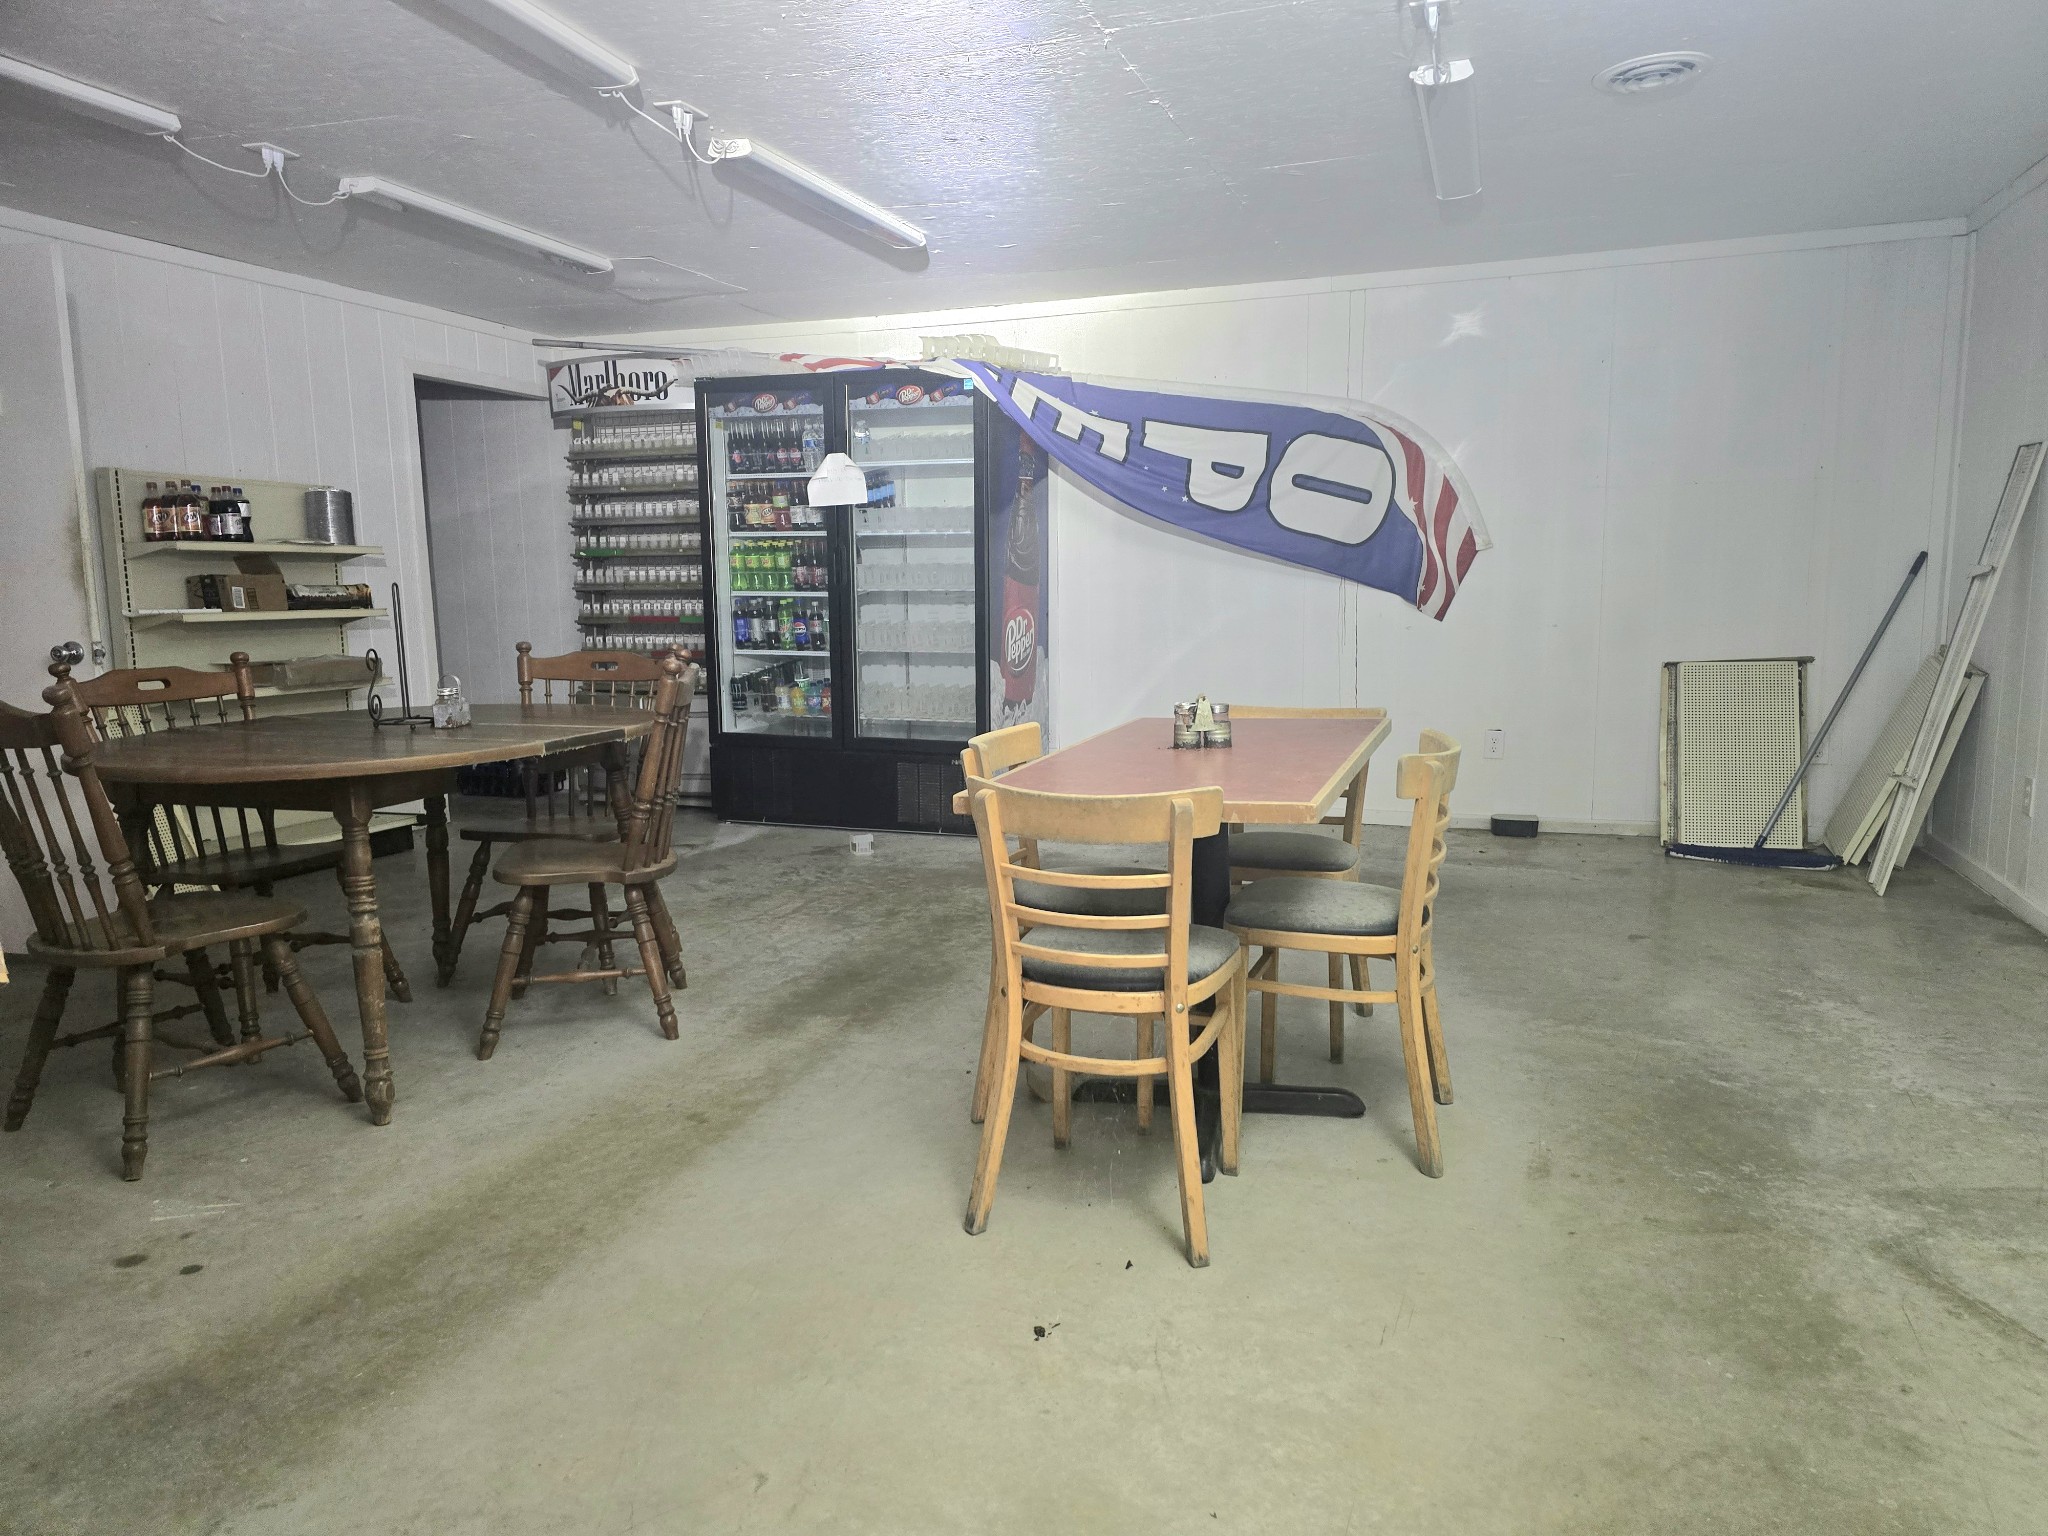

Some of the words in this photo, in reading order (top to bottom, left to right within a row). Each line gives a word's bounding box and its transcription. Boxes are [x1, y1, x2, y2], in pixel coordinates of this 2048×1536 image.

[567, 359, 669, 406] Marlboro
[985, 363, 1395, 546] OPE
[1006, 620, 1034, 664] Pepper
[1016, 615, 1028, 640] Dr
